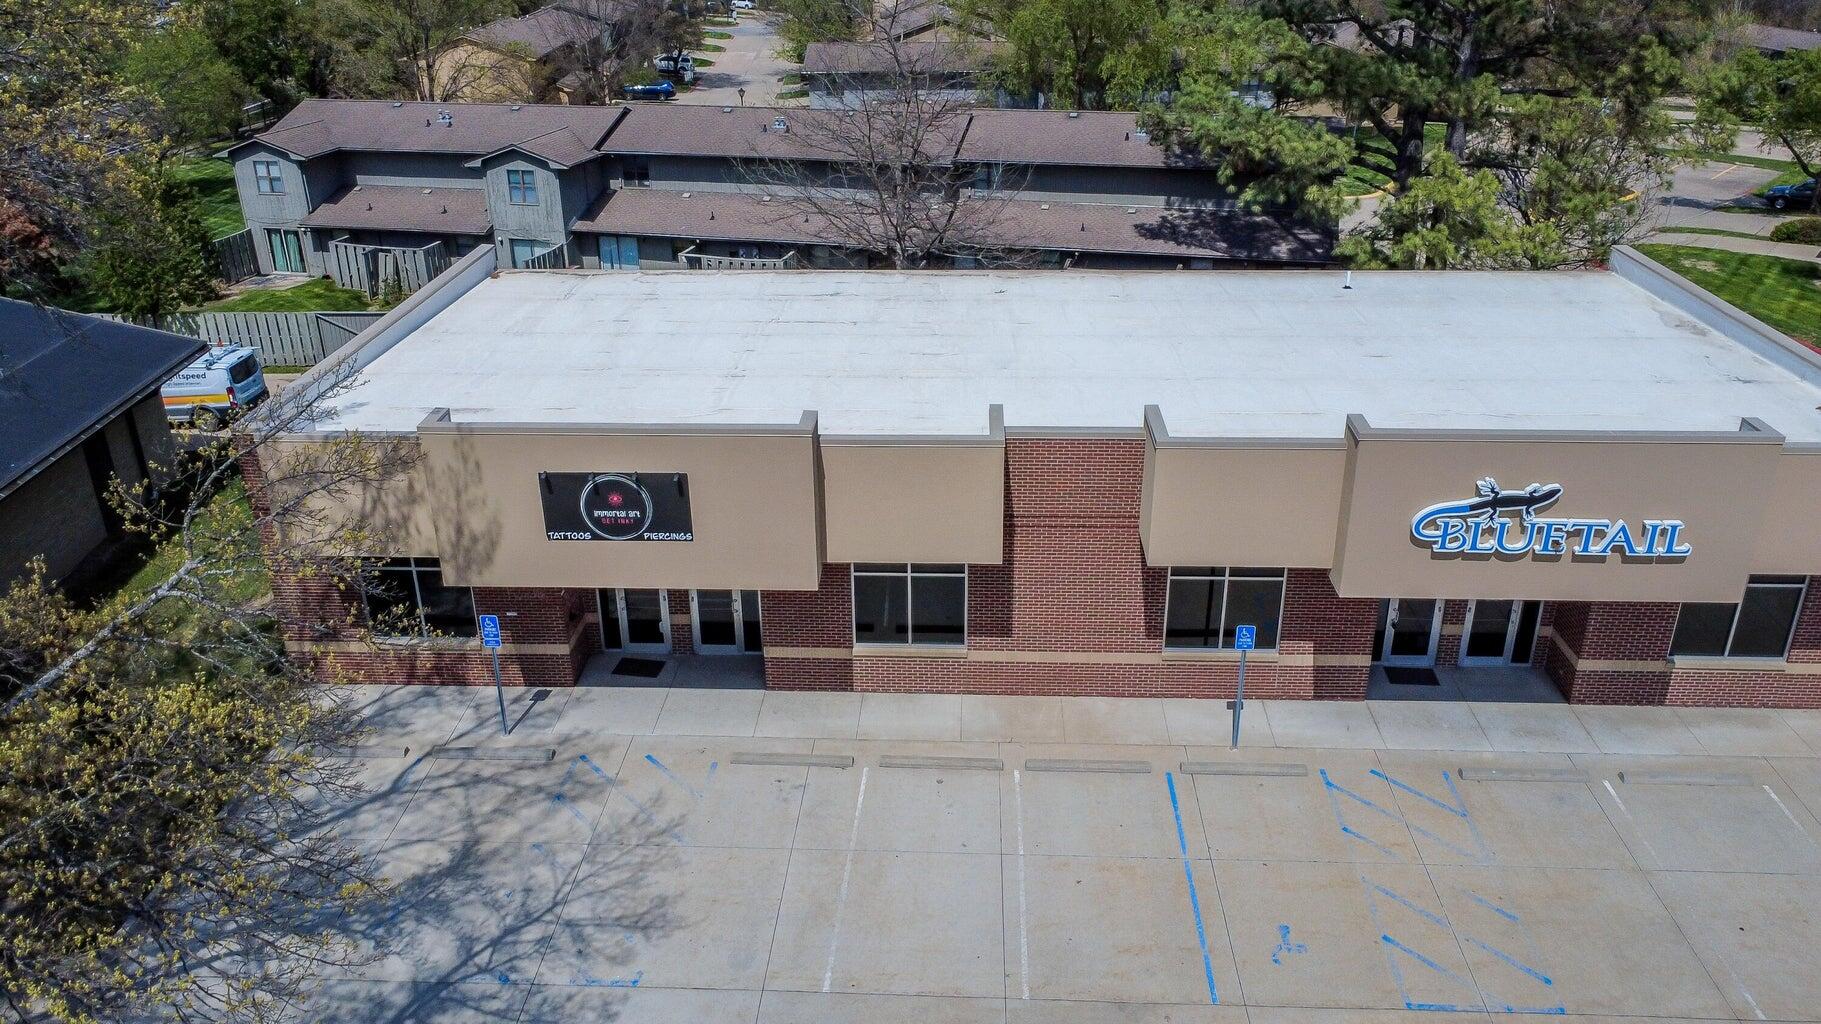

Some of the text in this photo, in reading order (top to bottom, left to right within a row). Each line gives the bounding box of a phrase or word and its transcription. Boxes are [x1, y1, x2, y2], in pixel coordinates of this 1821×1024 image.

[628, 510, 640, 518] art
[547, 531, 592, 540] TATTOOS
[643, 532, 693, 541] PIERCINGS
[1432, 517, 1692, 557] BLUETAIL
